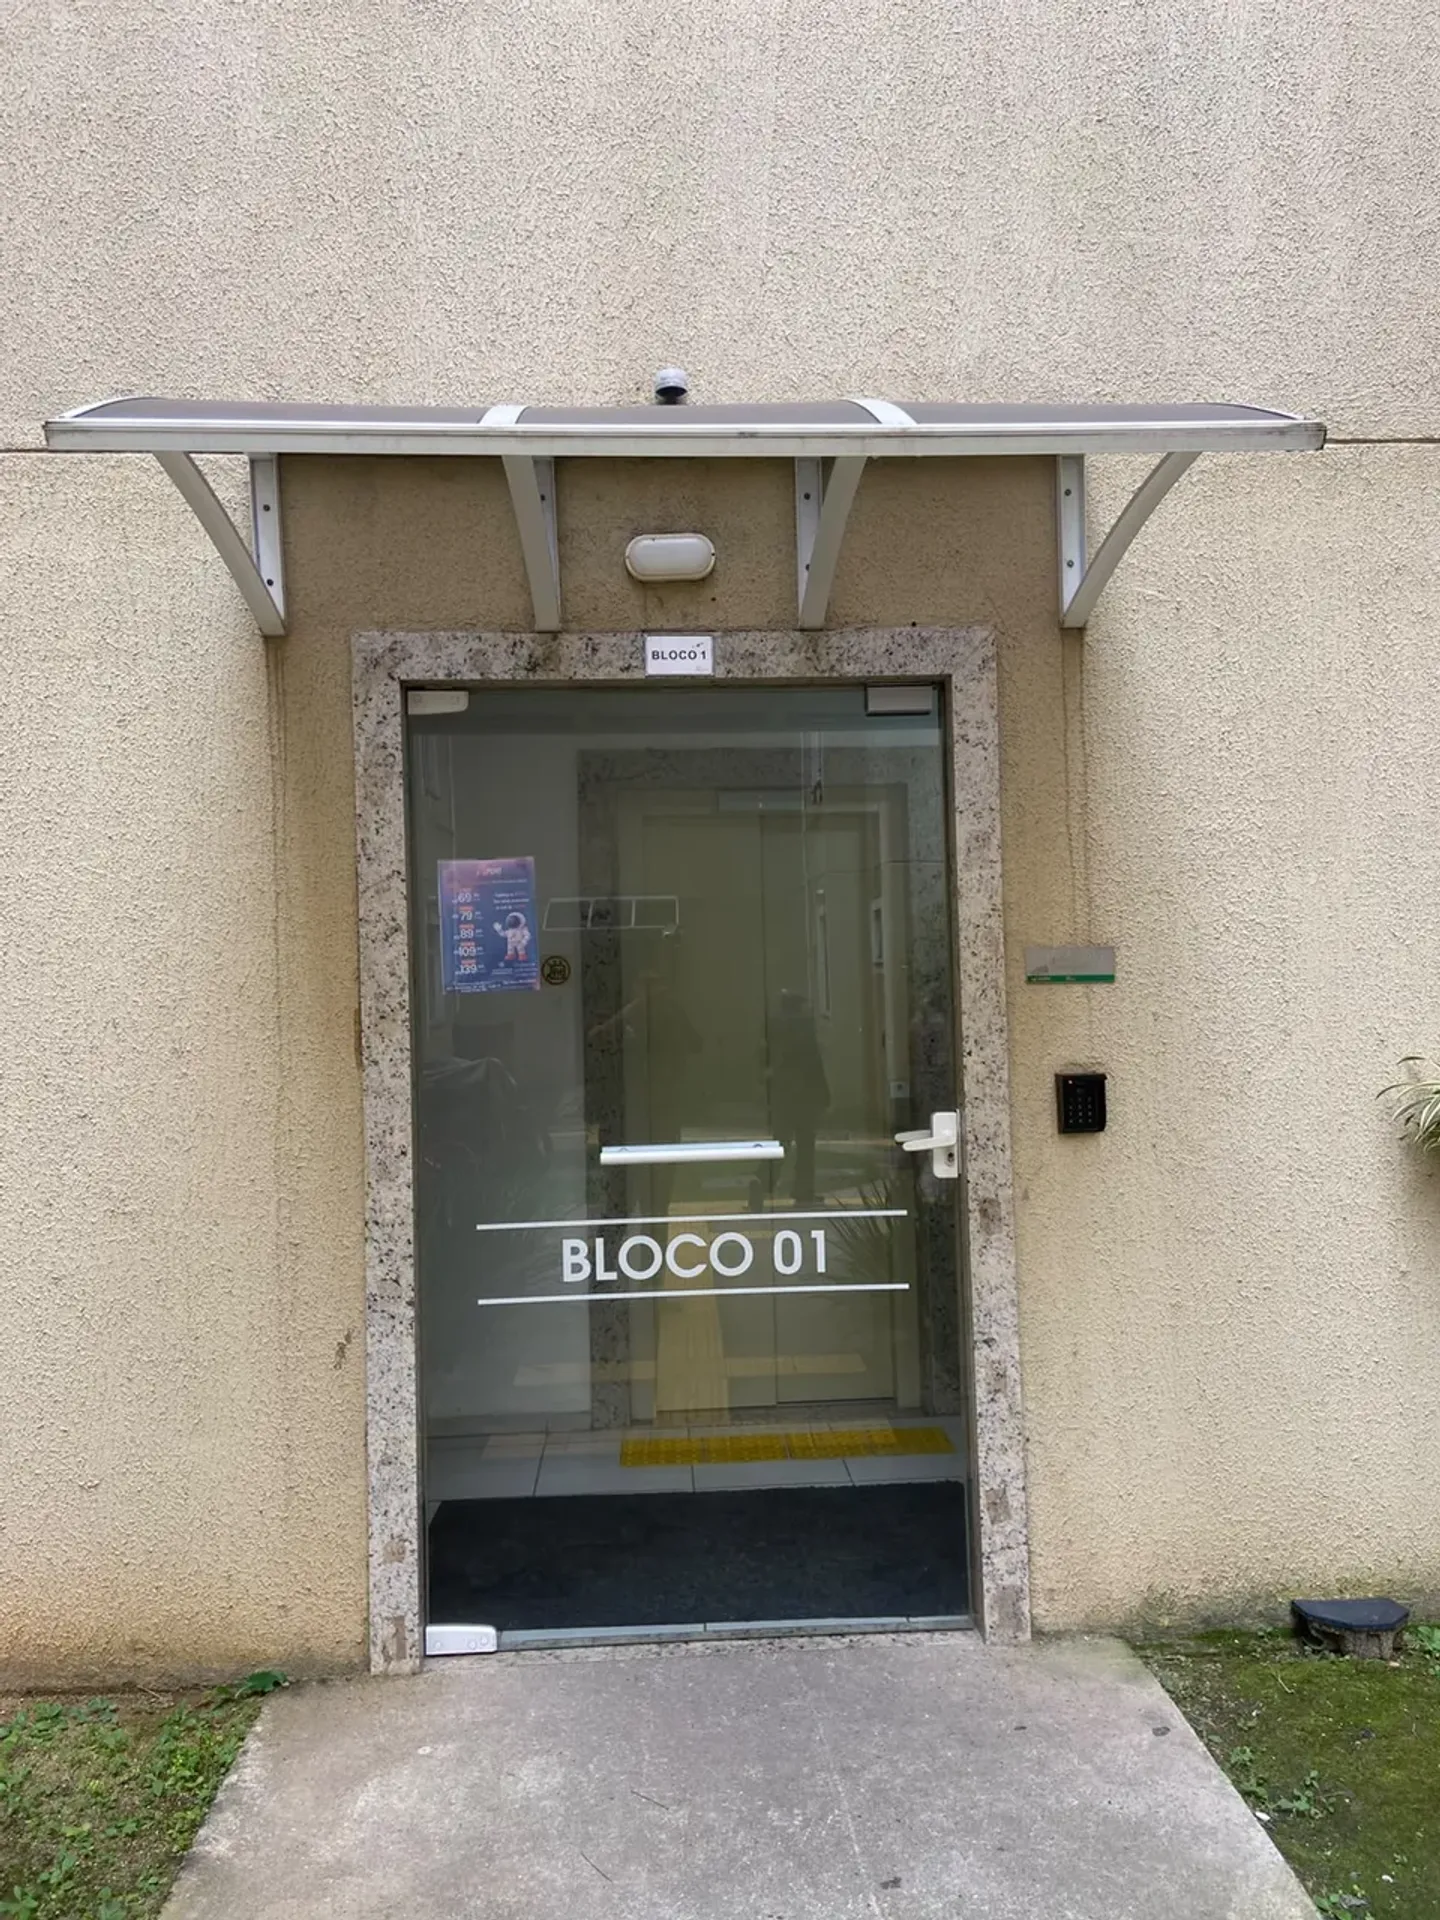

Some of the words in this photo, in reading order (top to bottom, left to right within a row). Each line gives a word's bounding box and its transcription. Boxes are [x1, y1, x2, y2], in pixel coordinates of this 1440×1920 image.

[651, 649, 697, 660] BLOCO
[700, 649, 706, 660] 1
[458, 892, 472, 903] 69
[459, 910, 473, 921] 79
[460, 928, 474, 939] 89
[458, 946, 477, 957] 109
[459, 964, 477, 975] 139
[562, 1232, 753, 1282] BLOCO
[773, 1230, 827, 1275] 01
